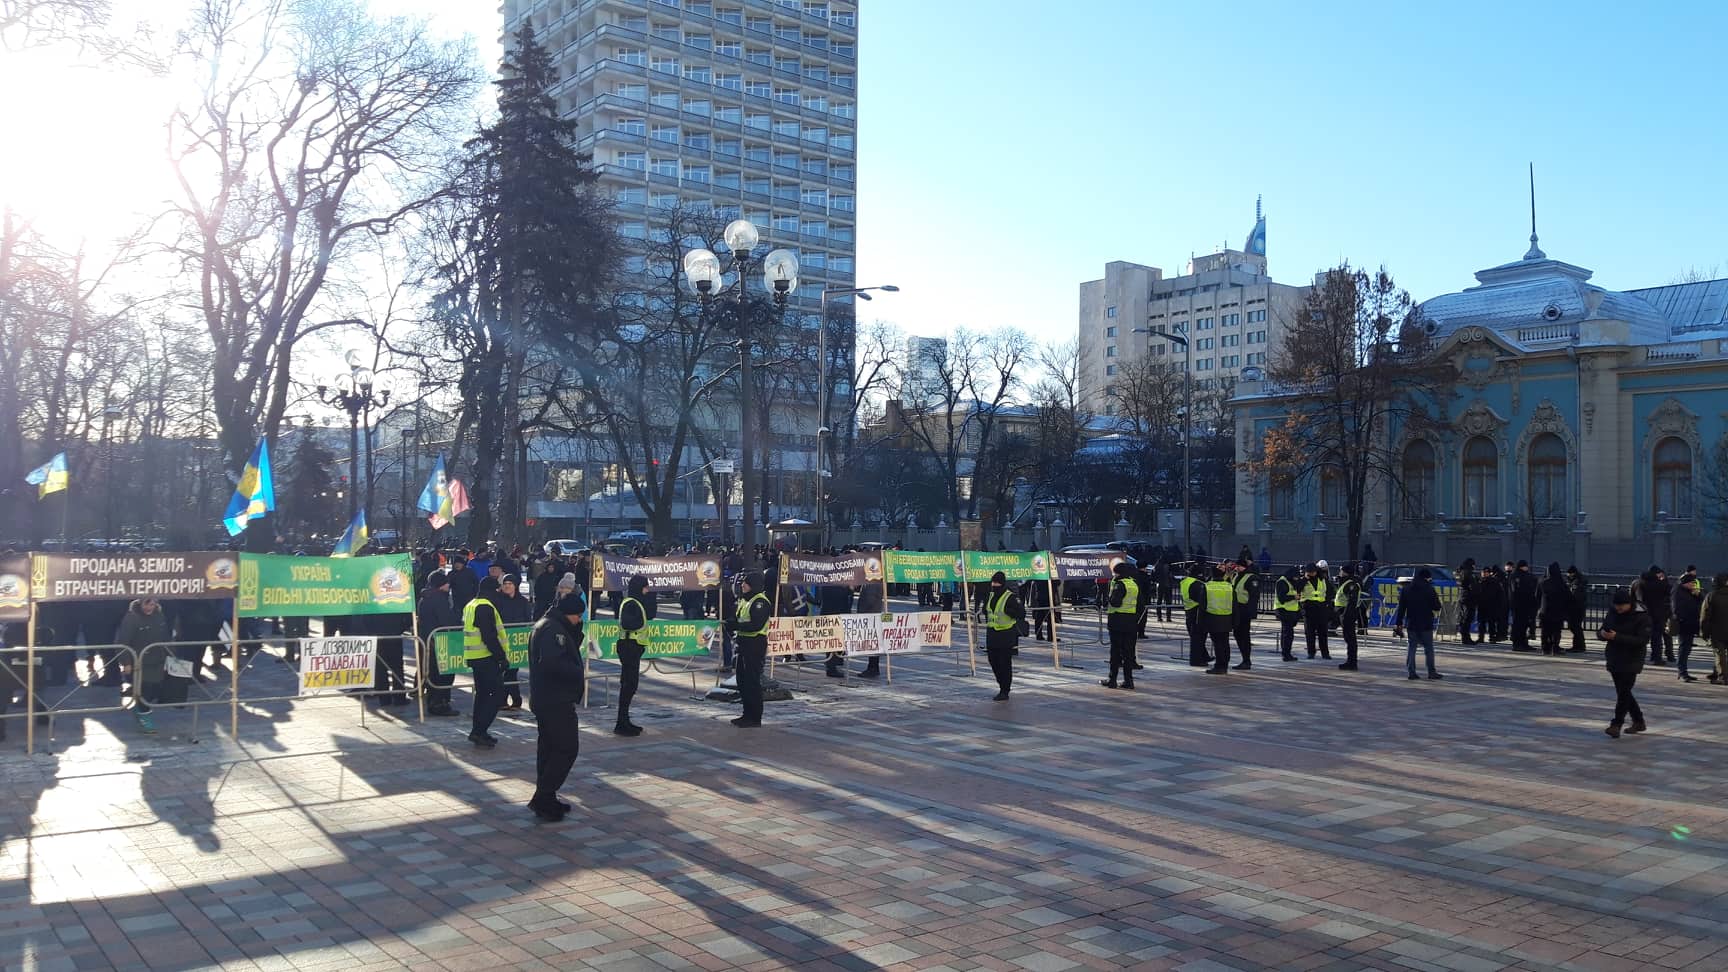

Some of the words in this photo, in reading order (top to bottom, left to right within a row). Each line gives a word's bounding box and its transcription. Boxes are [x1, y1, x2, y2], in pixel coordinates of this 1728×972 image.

[70, 558, 136, 576] ПРОДАНА
[139, 557, 184, 574] ЗЕМЛЯ
[663, 560, 699, 573] ОСОБАМИ
[979, 555, 1019, 566] ЗАХИСТИМО
[290, 563, 331, 582] УКРАЇНІ
[55, 579, 126, 597] ВТРАЧЕНА
[128, 577, 205, 595] ТЕРИТОРІЯ!
[653, 576, 684, 587] ЗЛОЧИН!
[263, 587, 303, 605] ВІЛЬНІ
[304, 588, 370, 605] ХЛІБОРОБИ!
[815, 616, 840, 628] ВІЙНА
[842, 617, 869, 630] ЗЕМЛЯ
[896, 613, 909, 627] НІ
[930, 613, 941, 624] НІ
[663, 624, 696, 637] ЗЕМЛЯ
[803, 628, 833, 639] ЗЕМЛЕЮ
[883, 627, 917, 640] ПРОДАЖУ
[920, 623, 948, 633] ПРОДАЖУ
[806, 638, 842, 650] ТОРГУЮТЬ
[925, 632, 943, 643] ЗЕМЛІ
[304, 641, 317, 656] НЕ
[320, 640, 373, 656] ДОЗВОЛИМО
[648, 641, 685, 655] КУСОК?
[888, 639, 909, 651] ЗЕМЛІ
[310, 654, 368, 671] ПРОДАВАТИ
